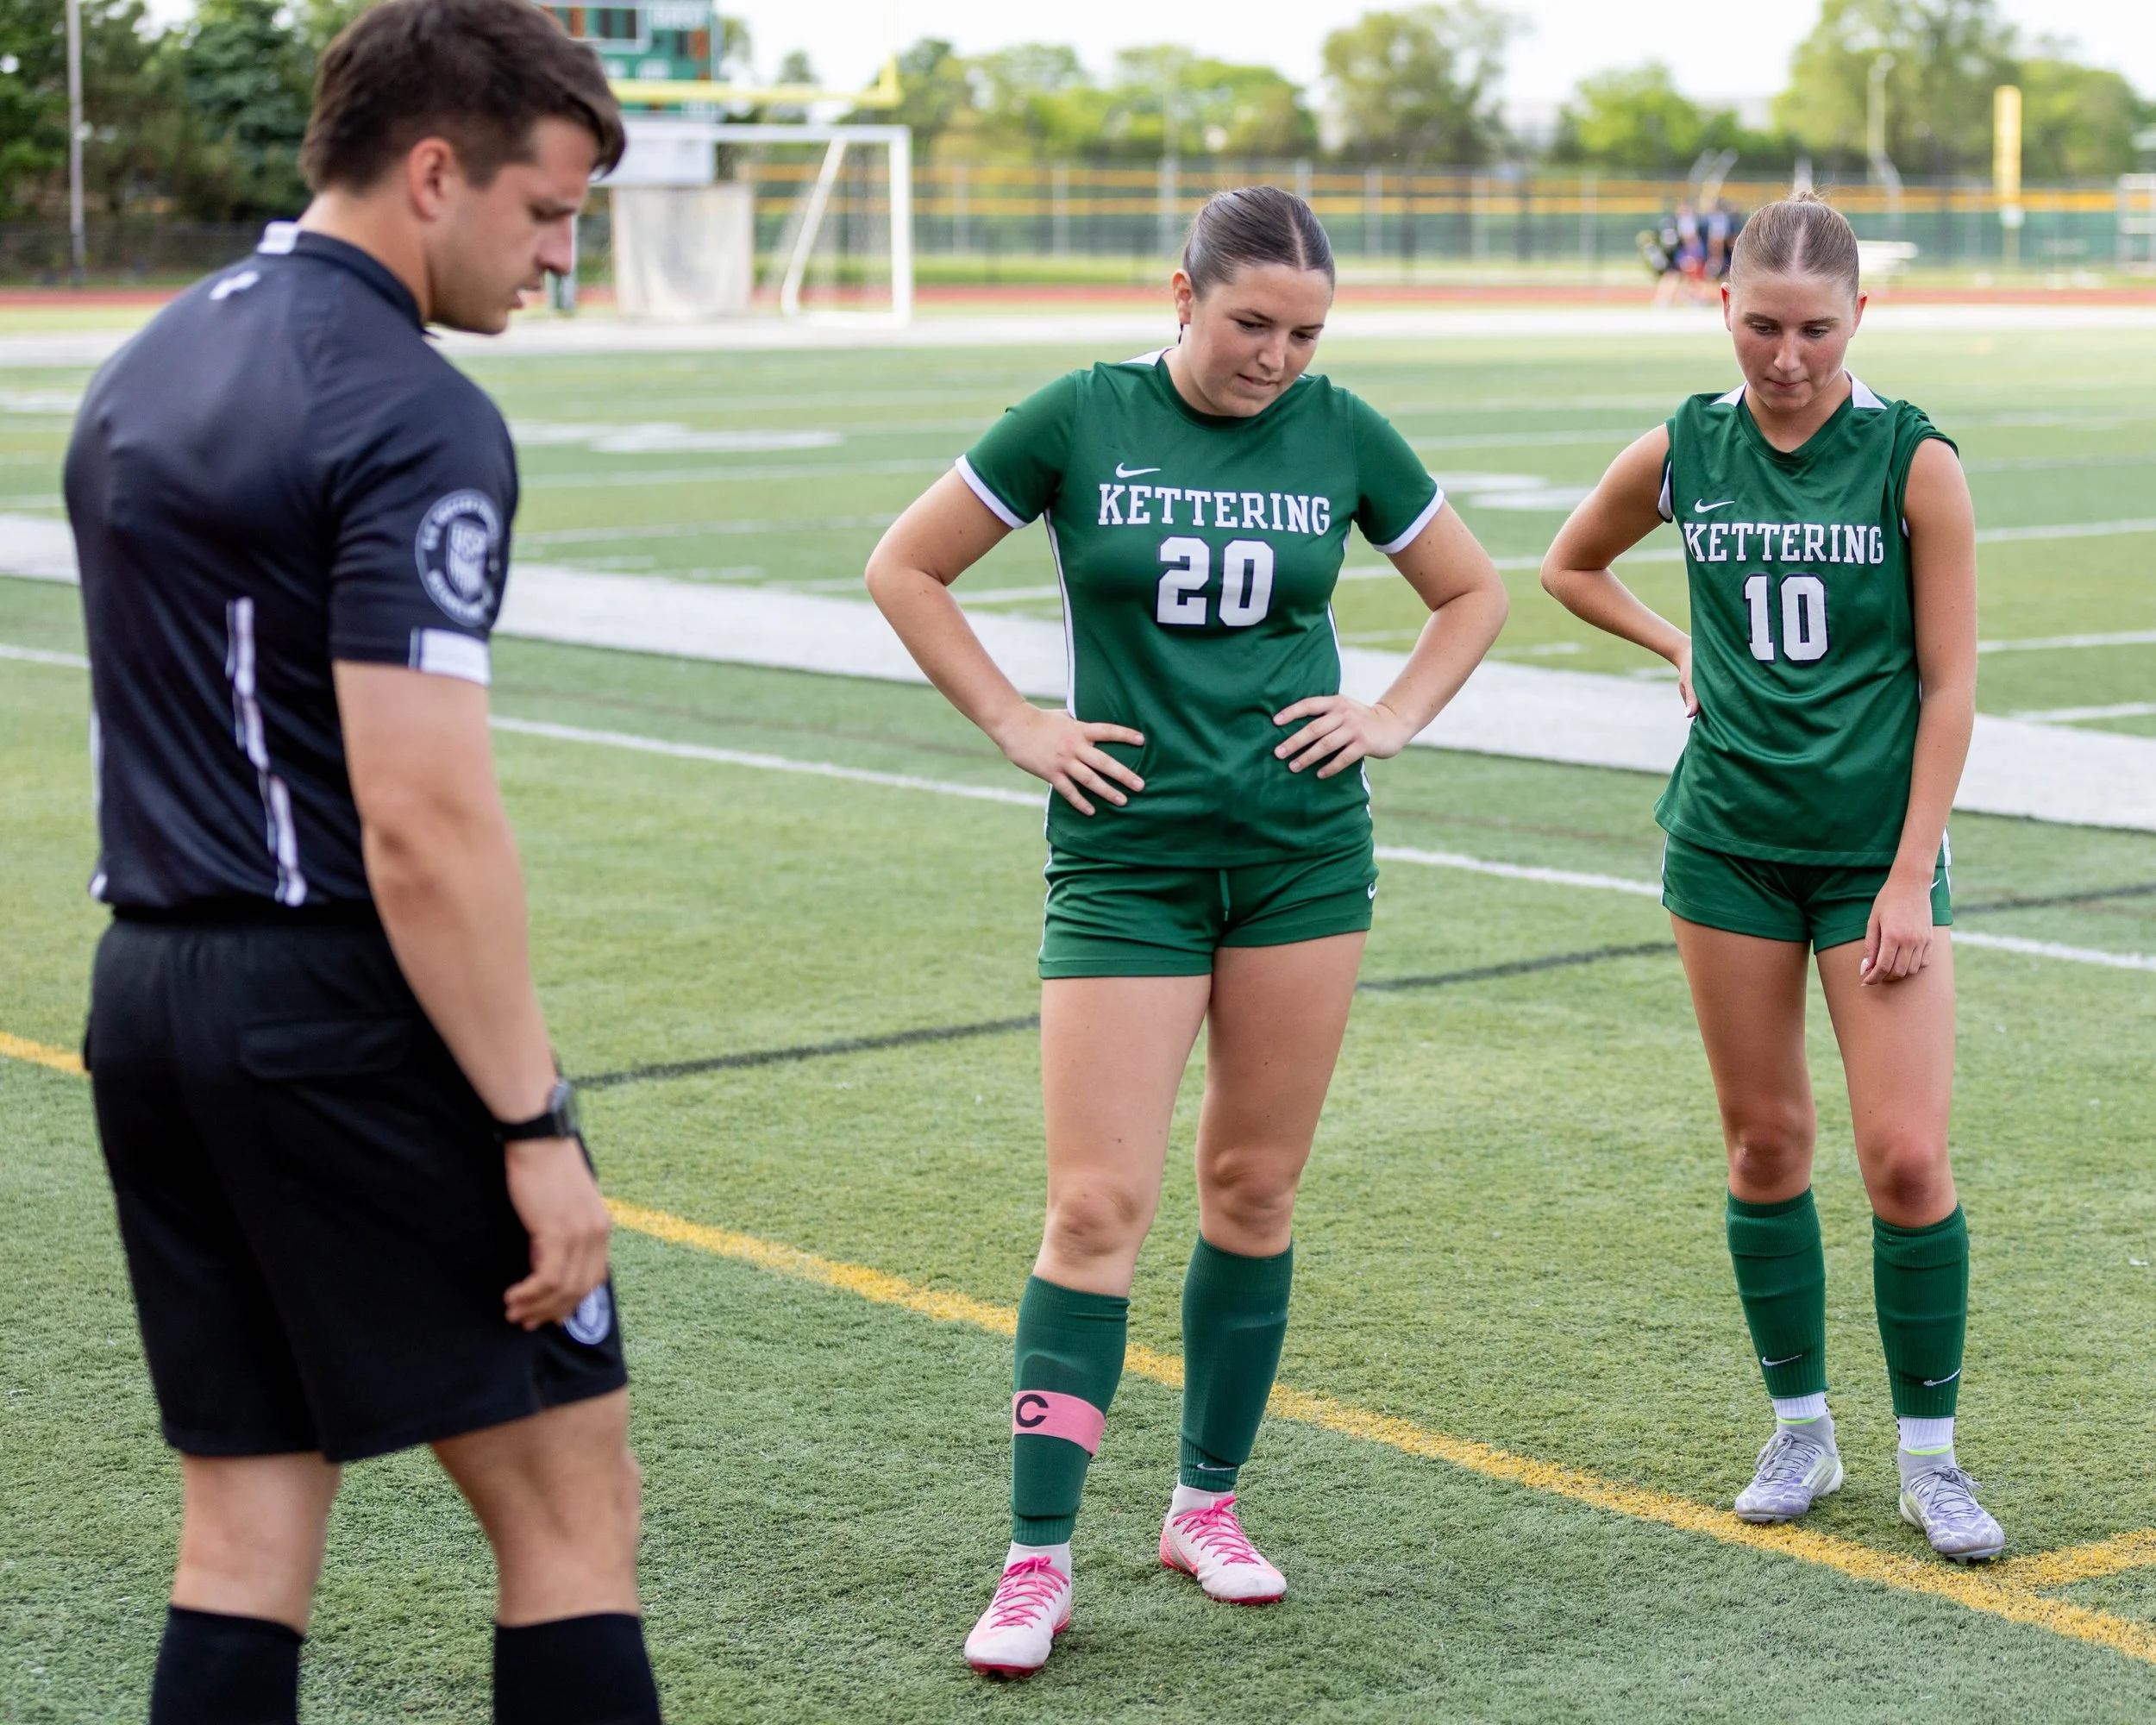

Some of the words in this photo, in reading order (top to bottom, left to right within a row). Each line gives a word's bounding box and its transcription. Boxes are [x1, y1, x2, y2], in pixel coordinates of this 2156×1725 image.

[1098, 484, 1331, 536] KETTERING
[1683, 522, 1883, 565] KETTERING
[1156, 536, 1275, 627] 20
[1744, 574, 1828, 662] 10
[1015, 1393, 1050, 1428] C
